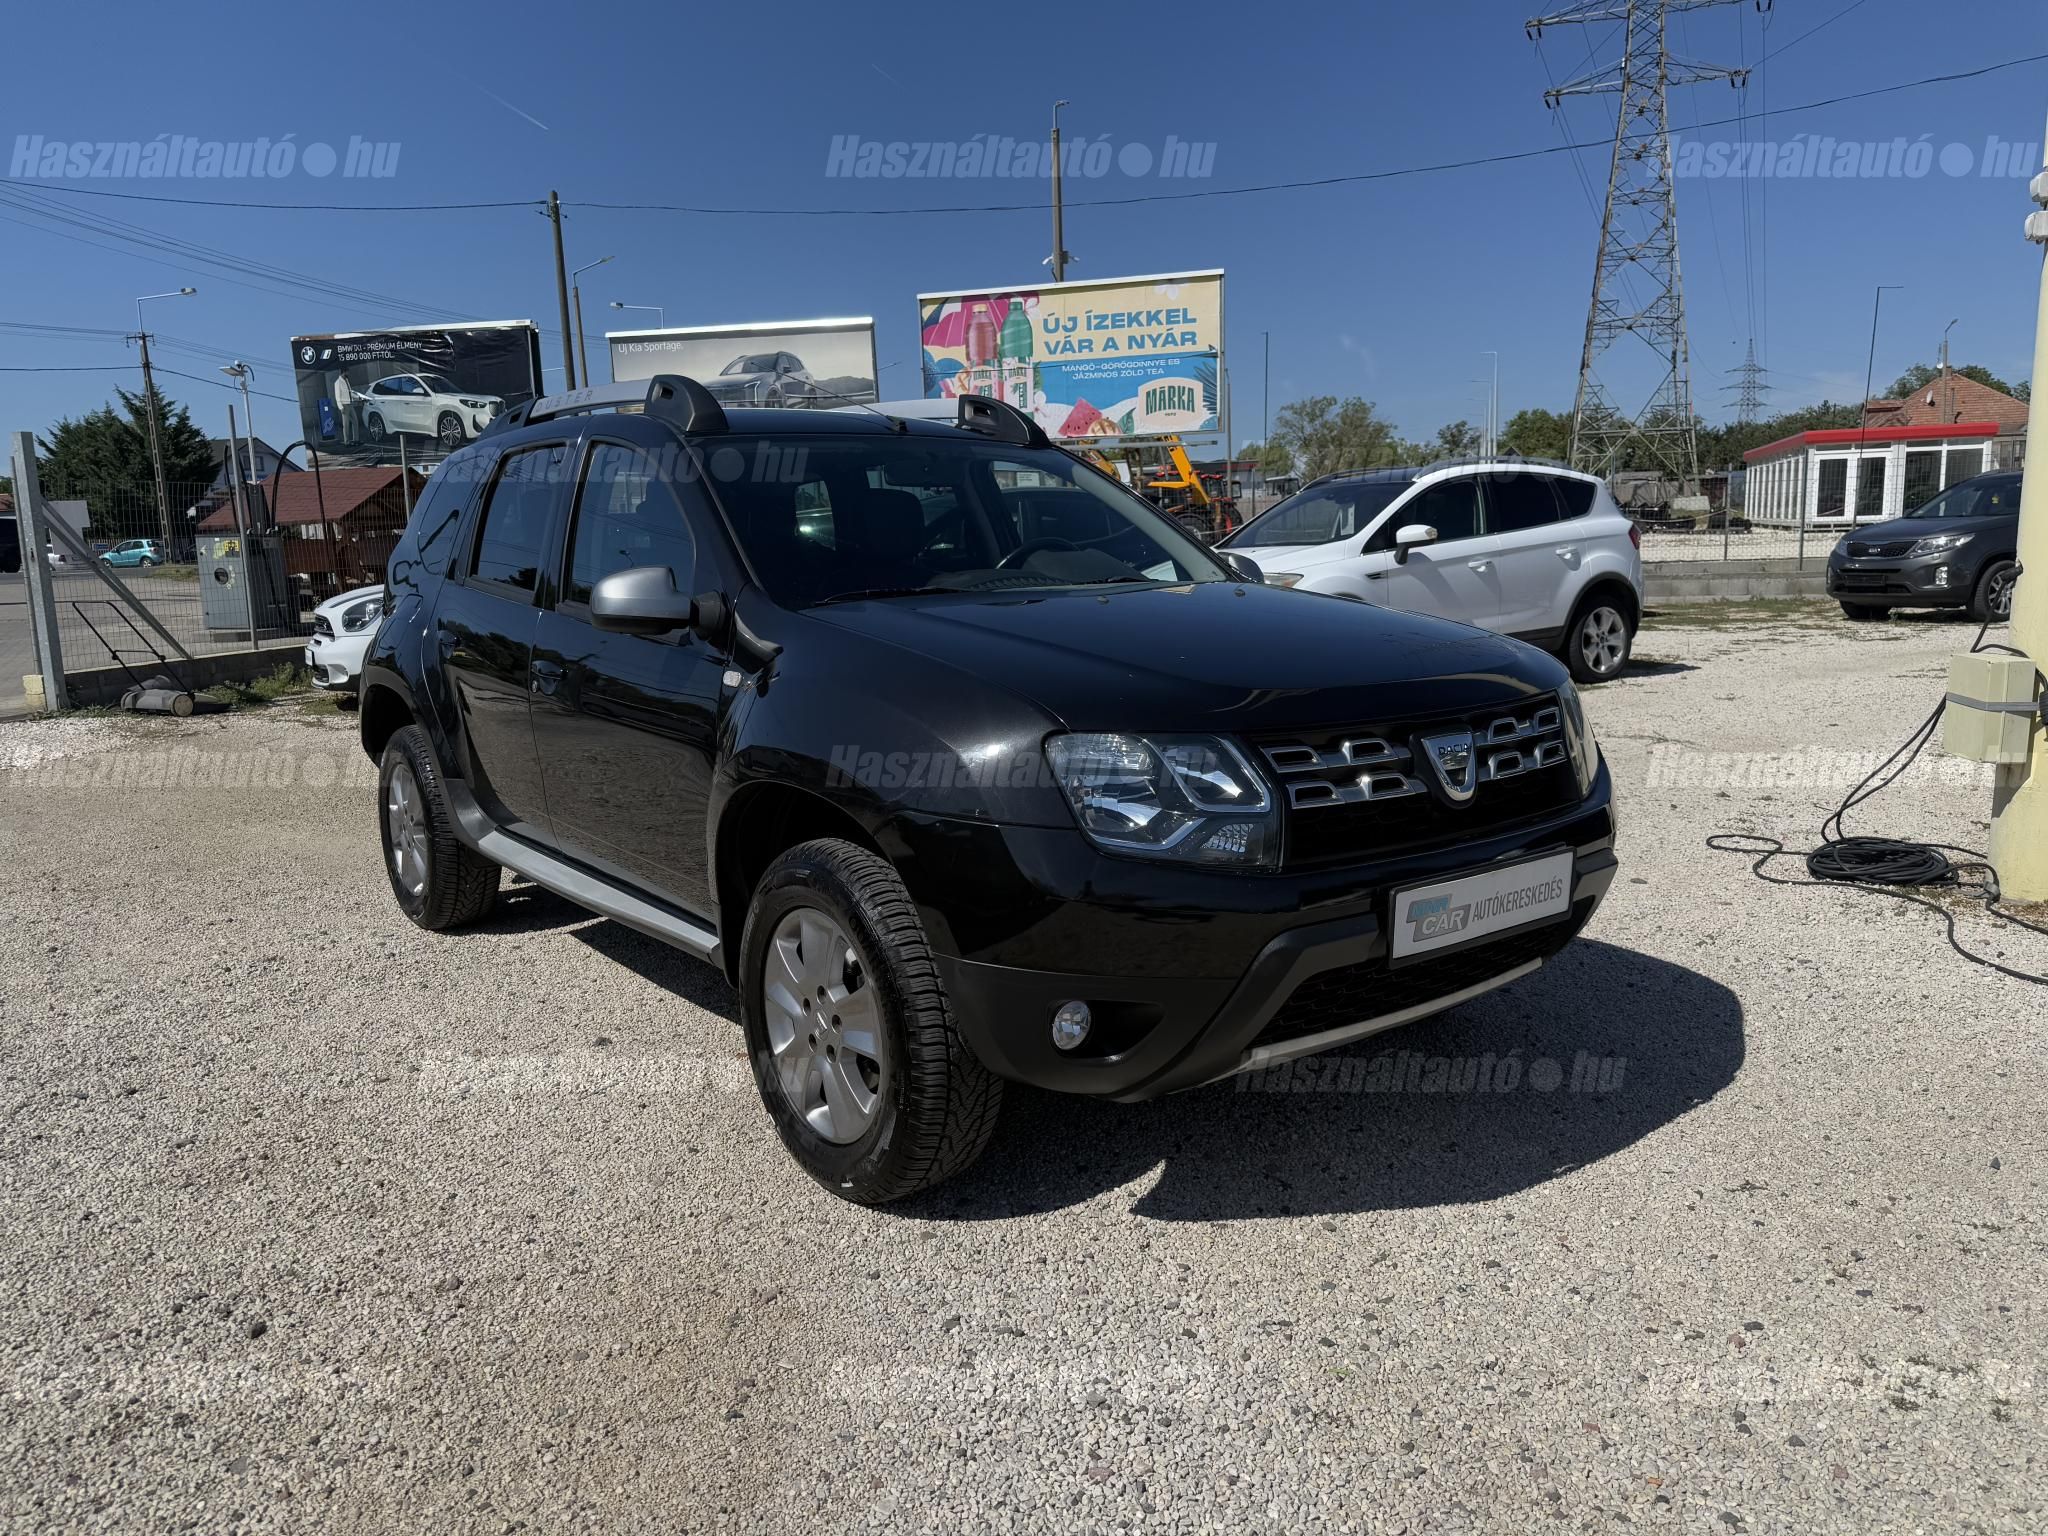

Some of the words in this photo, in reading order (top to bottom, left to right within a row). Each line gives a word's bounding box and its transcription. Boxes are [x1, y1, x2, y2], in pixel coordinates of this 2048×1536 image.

[1043, 312, 1078, 334] ÚJ
[1085, 308, 1197, 331] ÍZEKKEL
[629, 343, 642, 352] Kia
[1043, 335, 1094, 355] VÁR
[1102, 336, 1120, 352] A
[1127, 327, 1198, 350] NYÁR
[1072, 370, 1118, 380] JÁZMINOS
[535, 390, 593, 412] DUSTER
[1438, 743, 1472, 755] DACIA
[1421, 909, 1465, 935] CAR
[1472, 875, 1563, 922] AUTÓKERESKEDÉS
